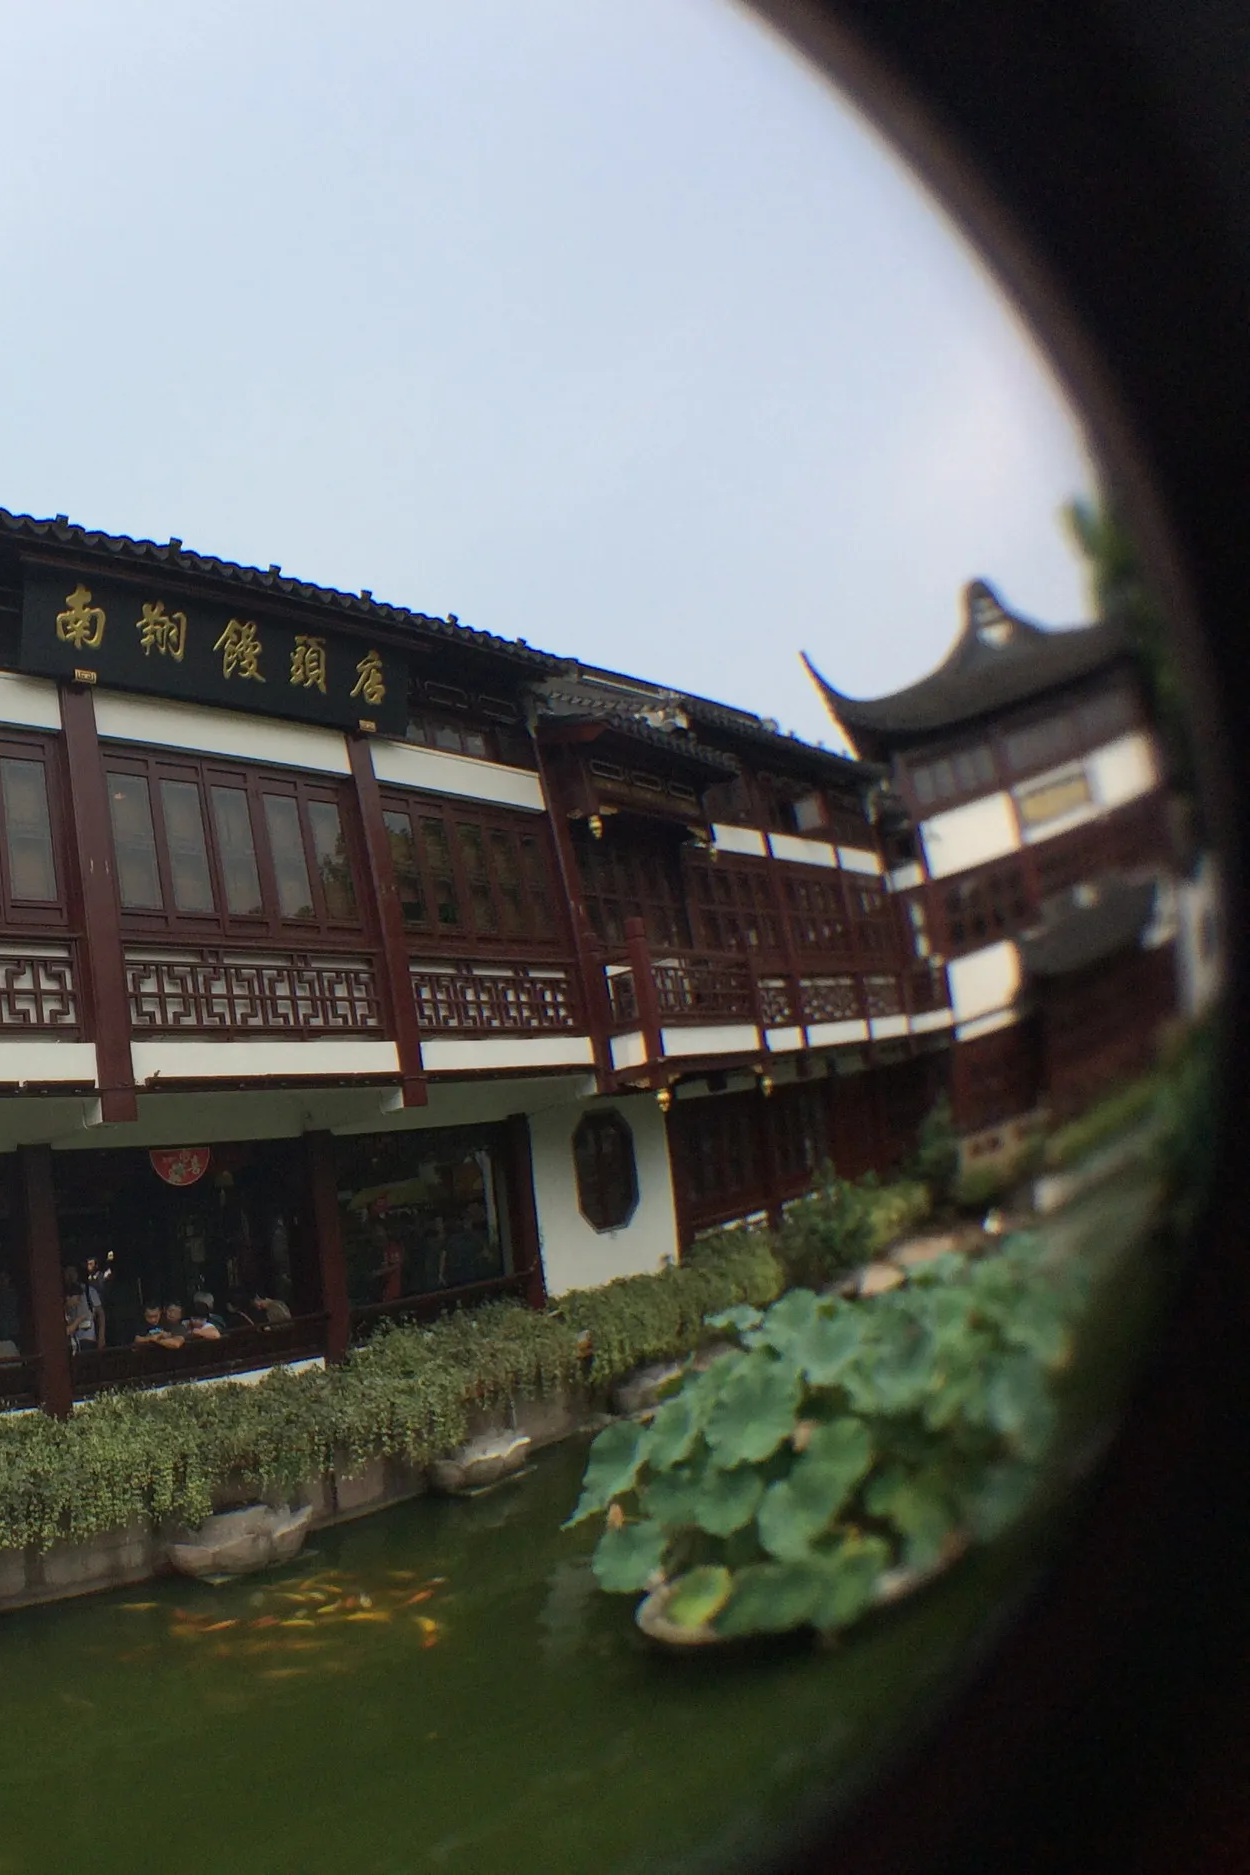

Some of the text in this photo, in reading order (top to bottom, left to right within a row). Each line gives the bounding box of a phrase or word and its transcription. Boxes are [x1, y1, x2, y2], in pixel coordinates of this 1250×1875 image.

[55, 584, 387, 705] 南翔饅頭店
